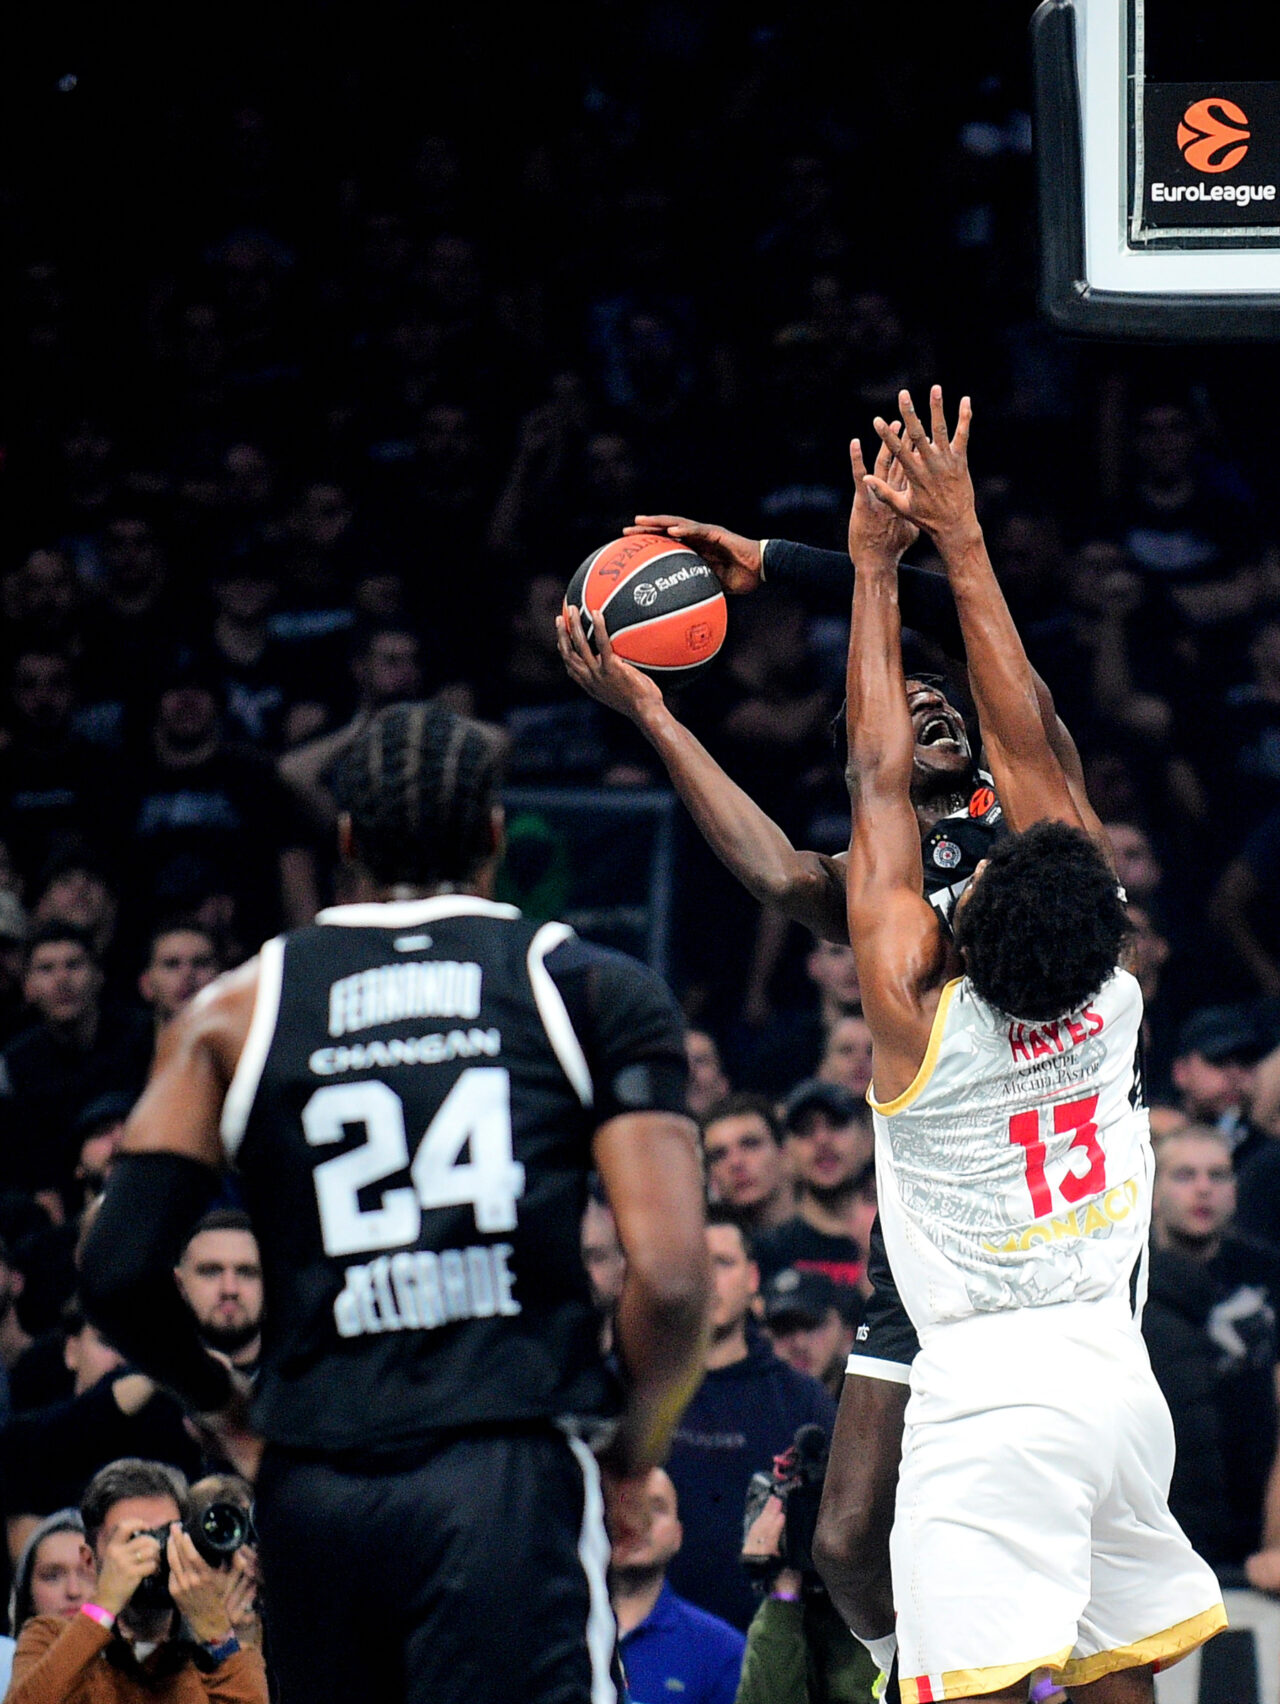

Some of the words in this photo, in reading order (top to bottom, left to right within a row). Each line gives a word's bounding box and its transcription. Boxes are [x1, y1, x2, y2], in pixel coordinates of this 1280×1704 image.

[1151, 182, 1276, 207] EuroLeague
[309, 1027, 500, 1075] CHANGAN
[1008, 1002, 1104, 1063] HAYES
[301, 1066, 525, 1257] 24
[1009, 1093, 1106, 1219] 13
